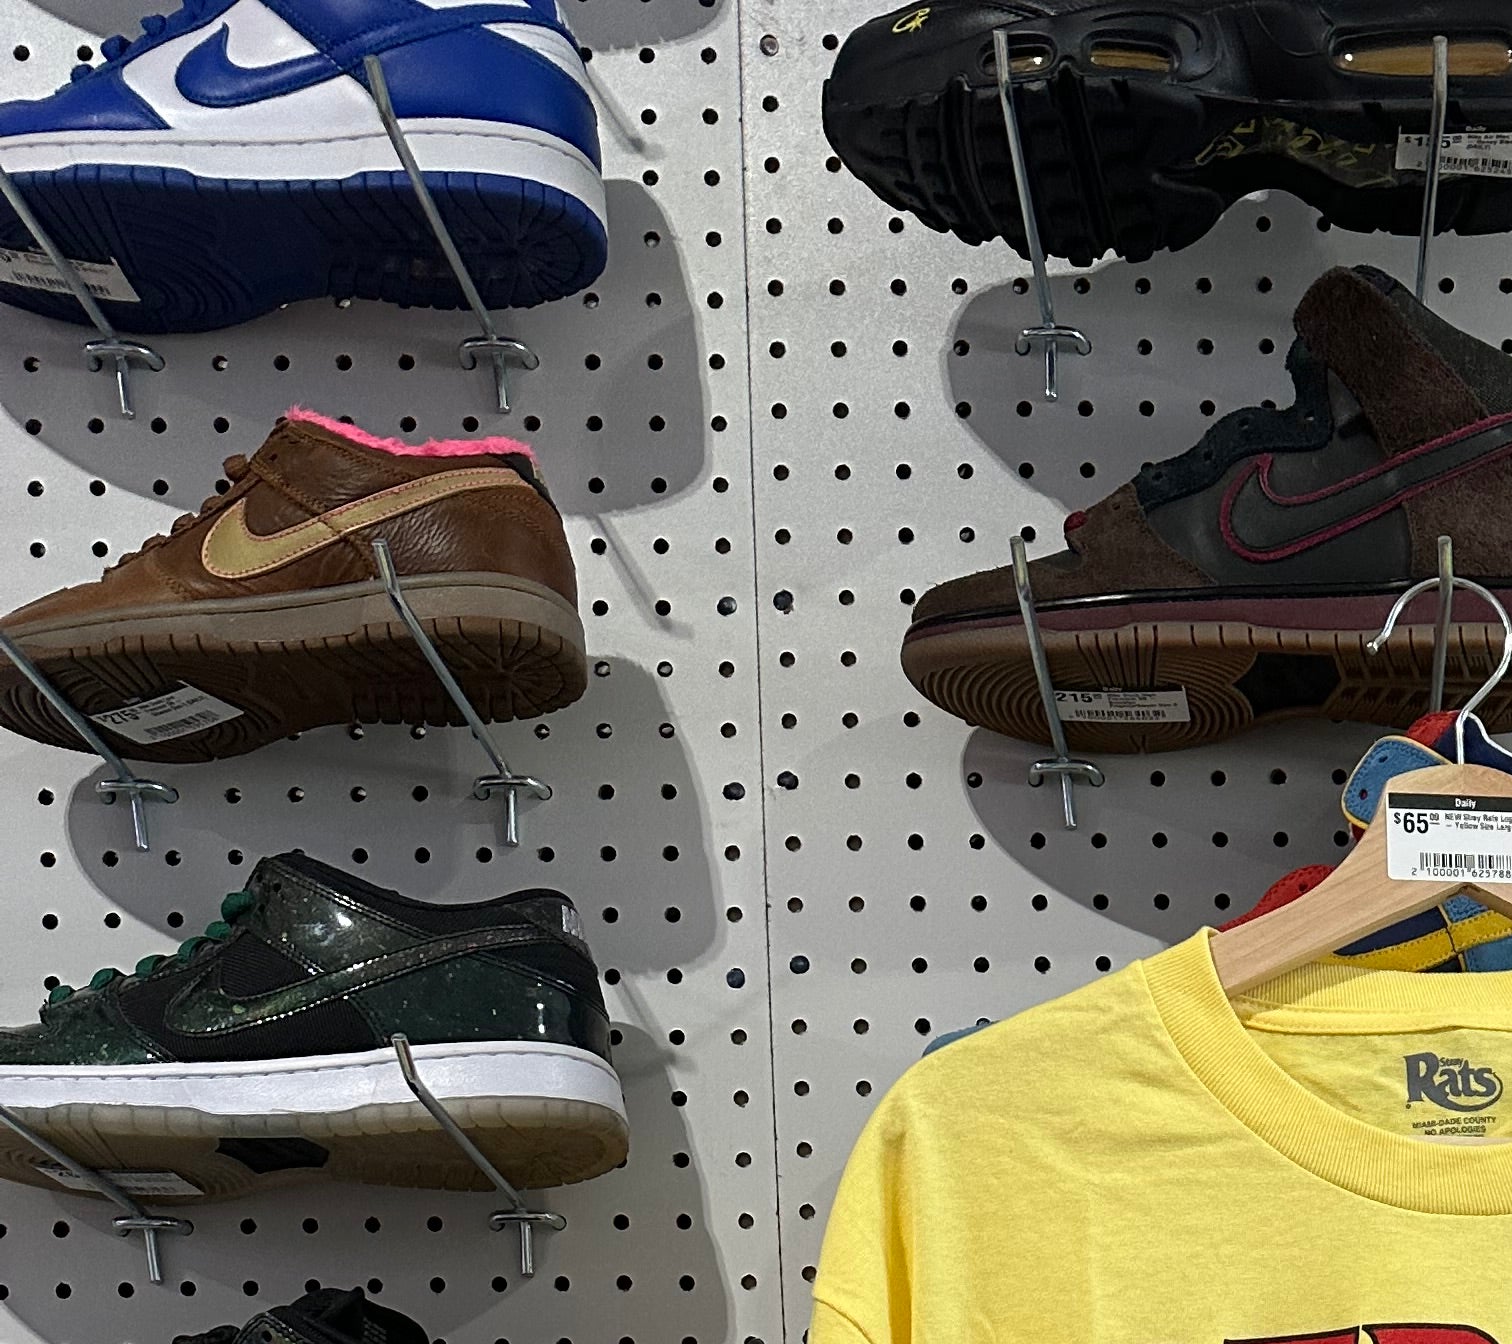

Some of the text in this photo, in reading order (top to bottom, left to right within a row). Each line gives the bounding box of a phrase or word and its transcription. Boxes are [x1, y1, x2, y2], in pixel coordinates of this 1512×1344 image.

[1454, 798, 1477, 809] Daily
[1427, 868, 1466, 877] 100001
[1471, 868, 1512, 879] 625788
[1403, 1052, 1503, 1112] Rats
[1463, 1116, 1497, 1125] COUNTY
